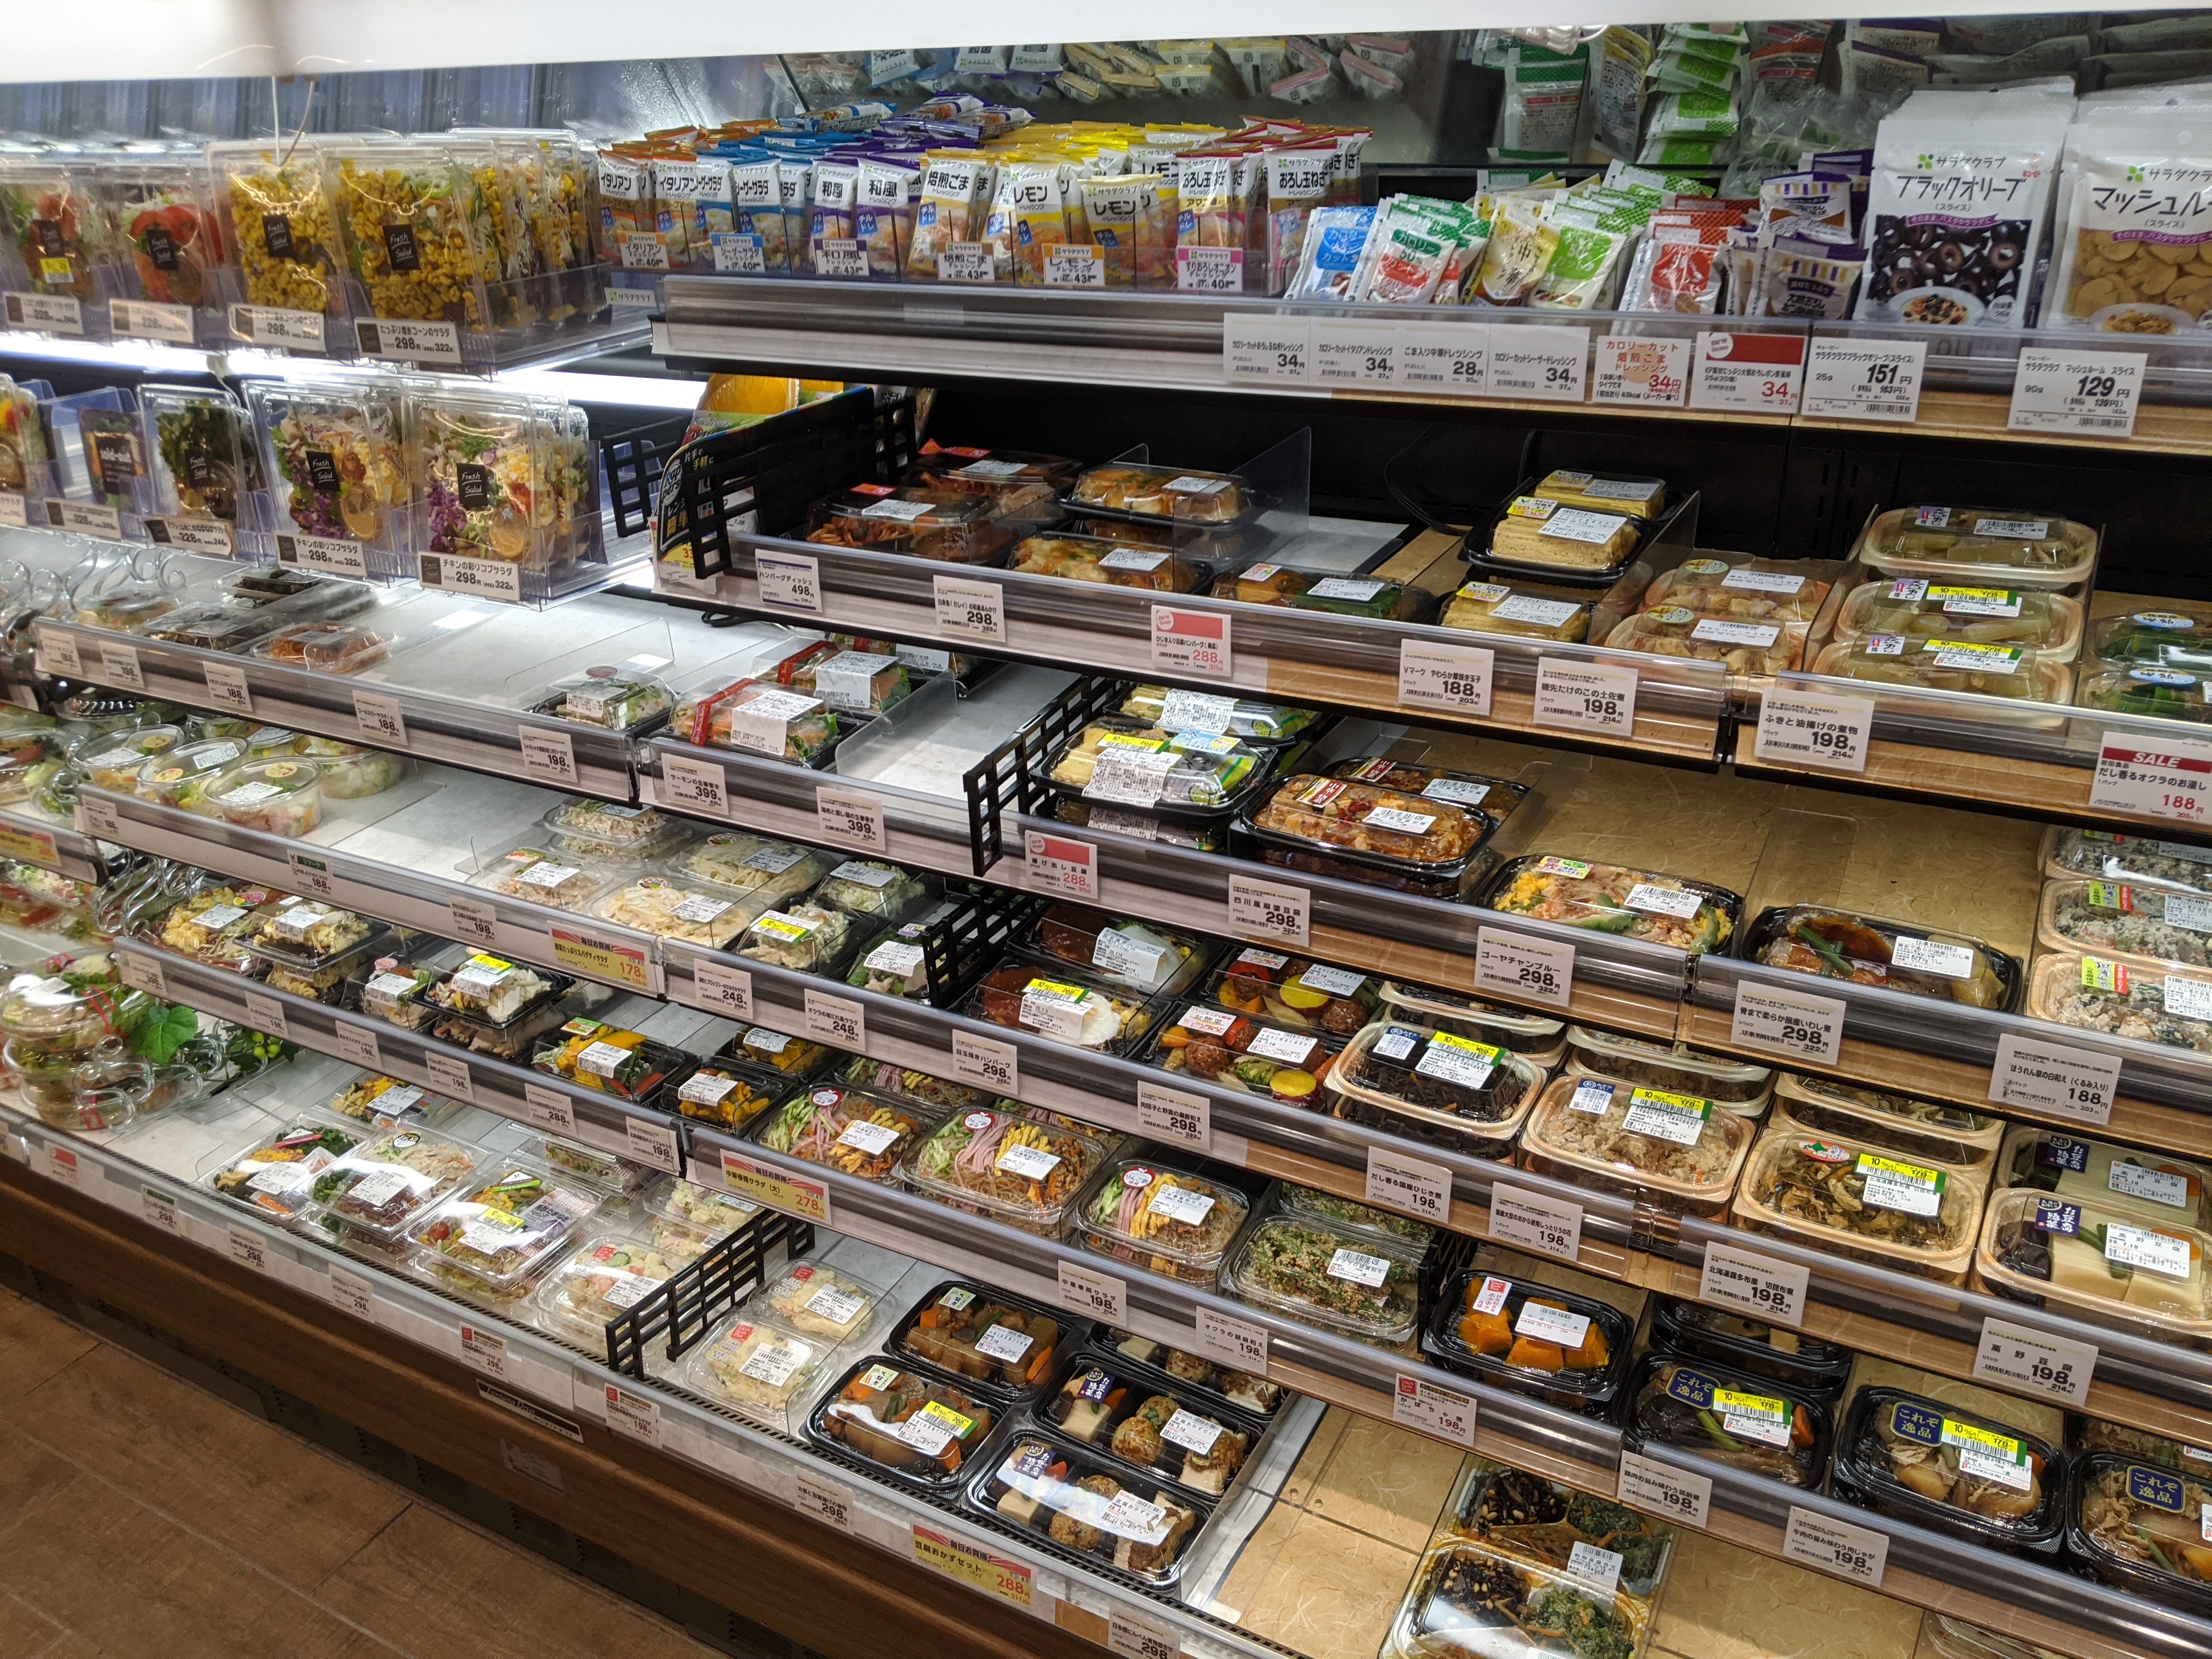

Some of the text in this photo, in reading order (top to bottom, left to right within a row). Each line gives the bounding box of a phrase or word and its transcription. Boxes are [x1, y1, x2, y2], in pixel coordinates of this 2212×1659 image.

[1937, 155, 2007, 171] サラダクラブ
[601, 174, 631, 192] イタリアン
[822, 179, 843, 199] 和風
[868, 178, 898, 198] 和風
[928, 169, 970, 190] 焙煎ごま
[1182, 170, 1228, 189] おろし玉ねぎ
[1279, 171, 1326, 189] おろし玉ねぎ
[1014, 185, 1048, 203] レモン
[1097, 186, 1137, 196] サラダクラブ
[1895, 176, 2027, 203] ブラックオリーブ
[1094, 200, 1136, 216] レモン
[625, 244, 662, 253] イタリアン
[1605, 341, 1679, 353] カロリーカット
[1615, 363, 1668, 373] ドレッシング
[1815, 373, 1833, 382] 25g
[312, 459, 330, 467] Fresh
[461, 471, 481, 481] Fresh
[465, 484, 482, 494] Salad
[296, 539, 358, 554] チキンの彩りコブサラダ
[443, 558, 514, 577] チキンの彩りコブサラダ
[759, 572, 813, 586] ハンバーグディッシュ
[1430, 668, 1482, 684] やわらか厚焼き玉子
[1541, 682, 1626, 702] 穂先たけのこの土佐煮
[1765, 713, 1859, 736] ふきと油揚げの煮物
[2132, 751, 2182, 769] SALE
[670, 774, 720, 790] サーモンの生春巻き
[2098, 766, 2208, 791] だし香るオクラのお浸し
[820, 805, 874, 823] 海老と蒸し鶏の生春巻き
[1031, 856, 1087, 875] 揚げ出し豆腐
[1233, 896, 1301, 917] 四川風麻婆豆腐
[1481, 950, 1562, 973] ゴーヤチャンプルー
[1739, 1007, 1832, 1033] 骨まで柔らか国産いわし煮
[956, 1047, 1011, 1069] 目玉焼きハンバーグ
[1139, 1101, 1202, 1125] 肉団子と野菜の黒酢和え
[1371, 1172, 1442, 1201] だし香る国産ひじき煮
[1494, 1208, 1572, 1238] 国産大豆のおから使用しっとりうの花
[1708, 1265, 1760, 1286] 北海道霧多布産
[1062, 1278, 1116, 1302] 中華春雨サラダ
[1204, 1323, 1264, 1349] オクラの胡麻和え
[1678, 1373, 1716, 1391] これぞ
[486, 1385, 536, 1415] Fontana Deux
[1675, 1384, 1705, 1403] 逸品
[1898, 1408, 1941, 1428] これぞ
[1901, 1421, 1933, 1440] 逸品
[1623, 1469, 1701, 1503] 鶏肉の旨み味わう筑前煮
[2133, 1471, 2180, 1493] これぞ
[2138, 1487, 2173, 1505] 逸品
[1793, 1527, 1877, 1560] 牛肉の旨み味わう肉じゃが
[914, 1540, 983, 1572] 豆腐おかずセット
